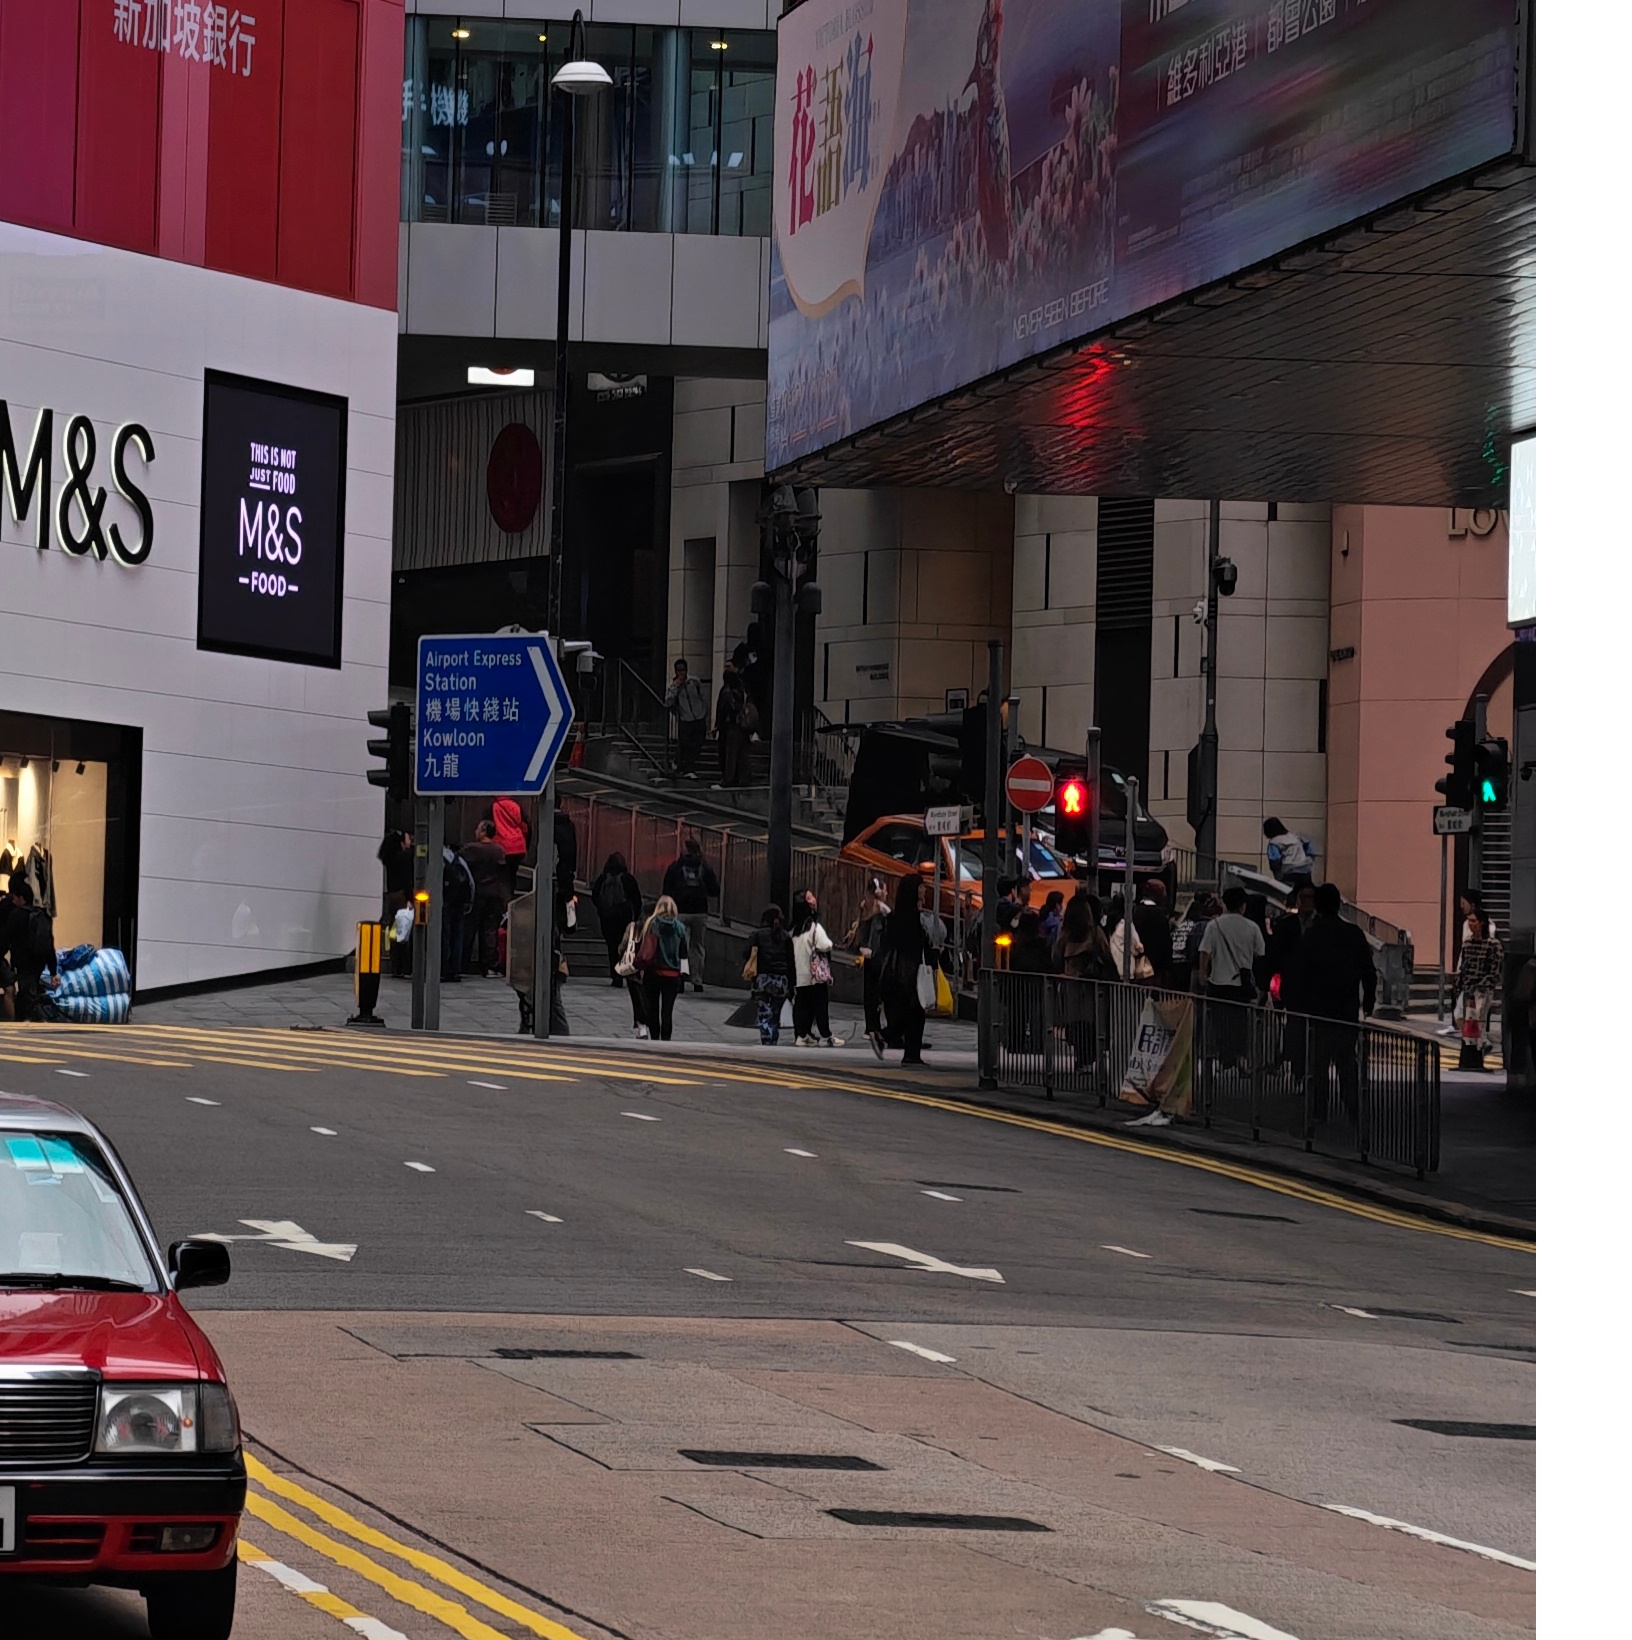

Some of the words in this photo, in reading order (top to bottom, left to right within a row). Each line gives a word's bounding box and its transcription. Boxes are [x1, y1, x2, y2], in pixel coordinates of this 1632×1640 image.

[1166, 19, 1249, 107] 維多利亞港
[1013, 306, 1044, 342] NEVER
[1069, 277, 1109, 317] BEFORE
[250, 441, 269, 465] THIS
[270, 446, 279, 467] IS
[280, 449, 297, 471] NOT
[250, 468, 271, 485] JUST
[273, 471, 296, 495] FOOD
[239, 497, 303, 566] M&S
[425, 649, 469, 670] Airport
[473, 649, 522, 670] Express
[424, 672, 477, 692] Station
[423, 727, 485, 748] Kowloon
[423, 752, 460, 779] 九龍
